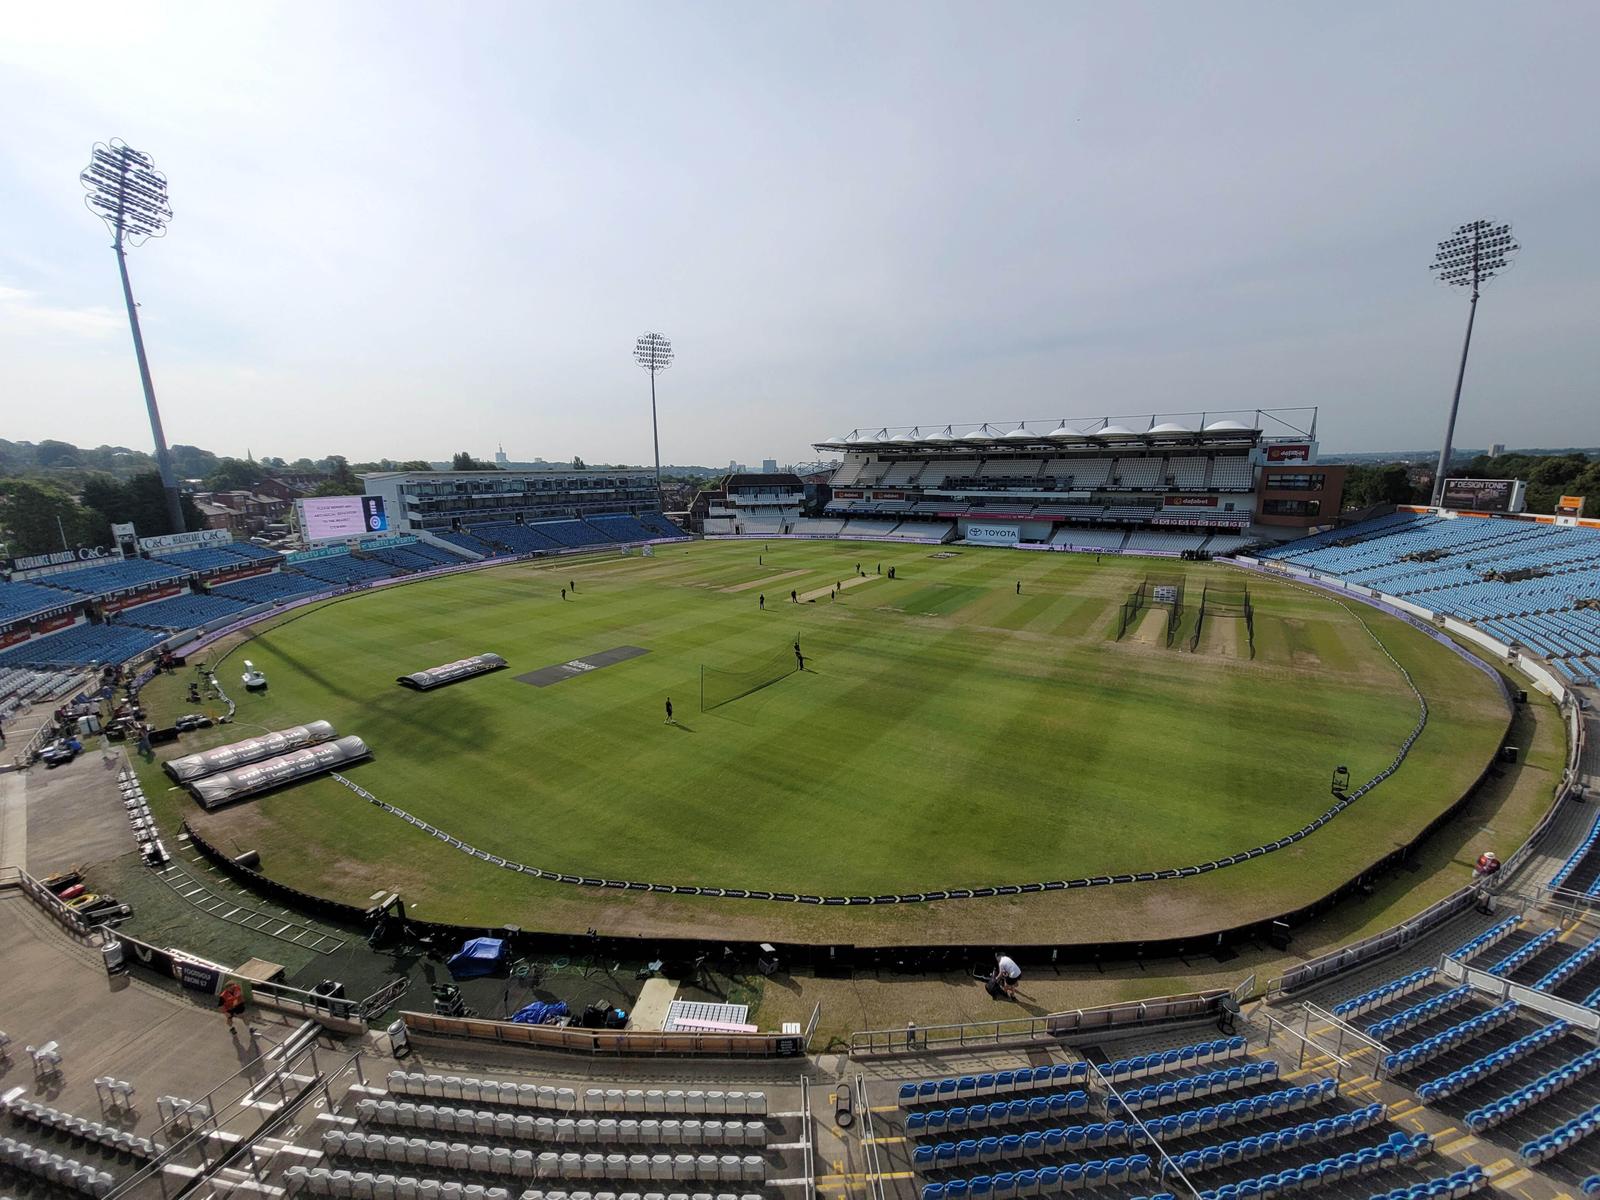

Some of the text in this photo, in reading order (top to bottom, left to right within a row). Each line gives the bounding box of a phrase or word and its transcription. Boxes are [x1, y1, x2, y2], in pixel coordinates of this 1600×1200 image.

[246, 776, 267, 786] Rent
[314, 1096, 327, 1108] G
[828, 1093, 837, 1105] F
[285, 1124, 302, 1137] H
[832, 1160, 844, 1174] H
